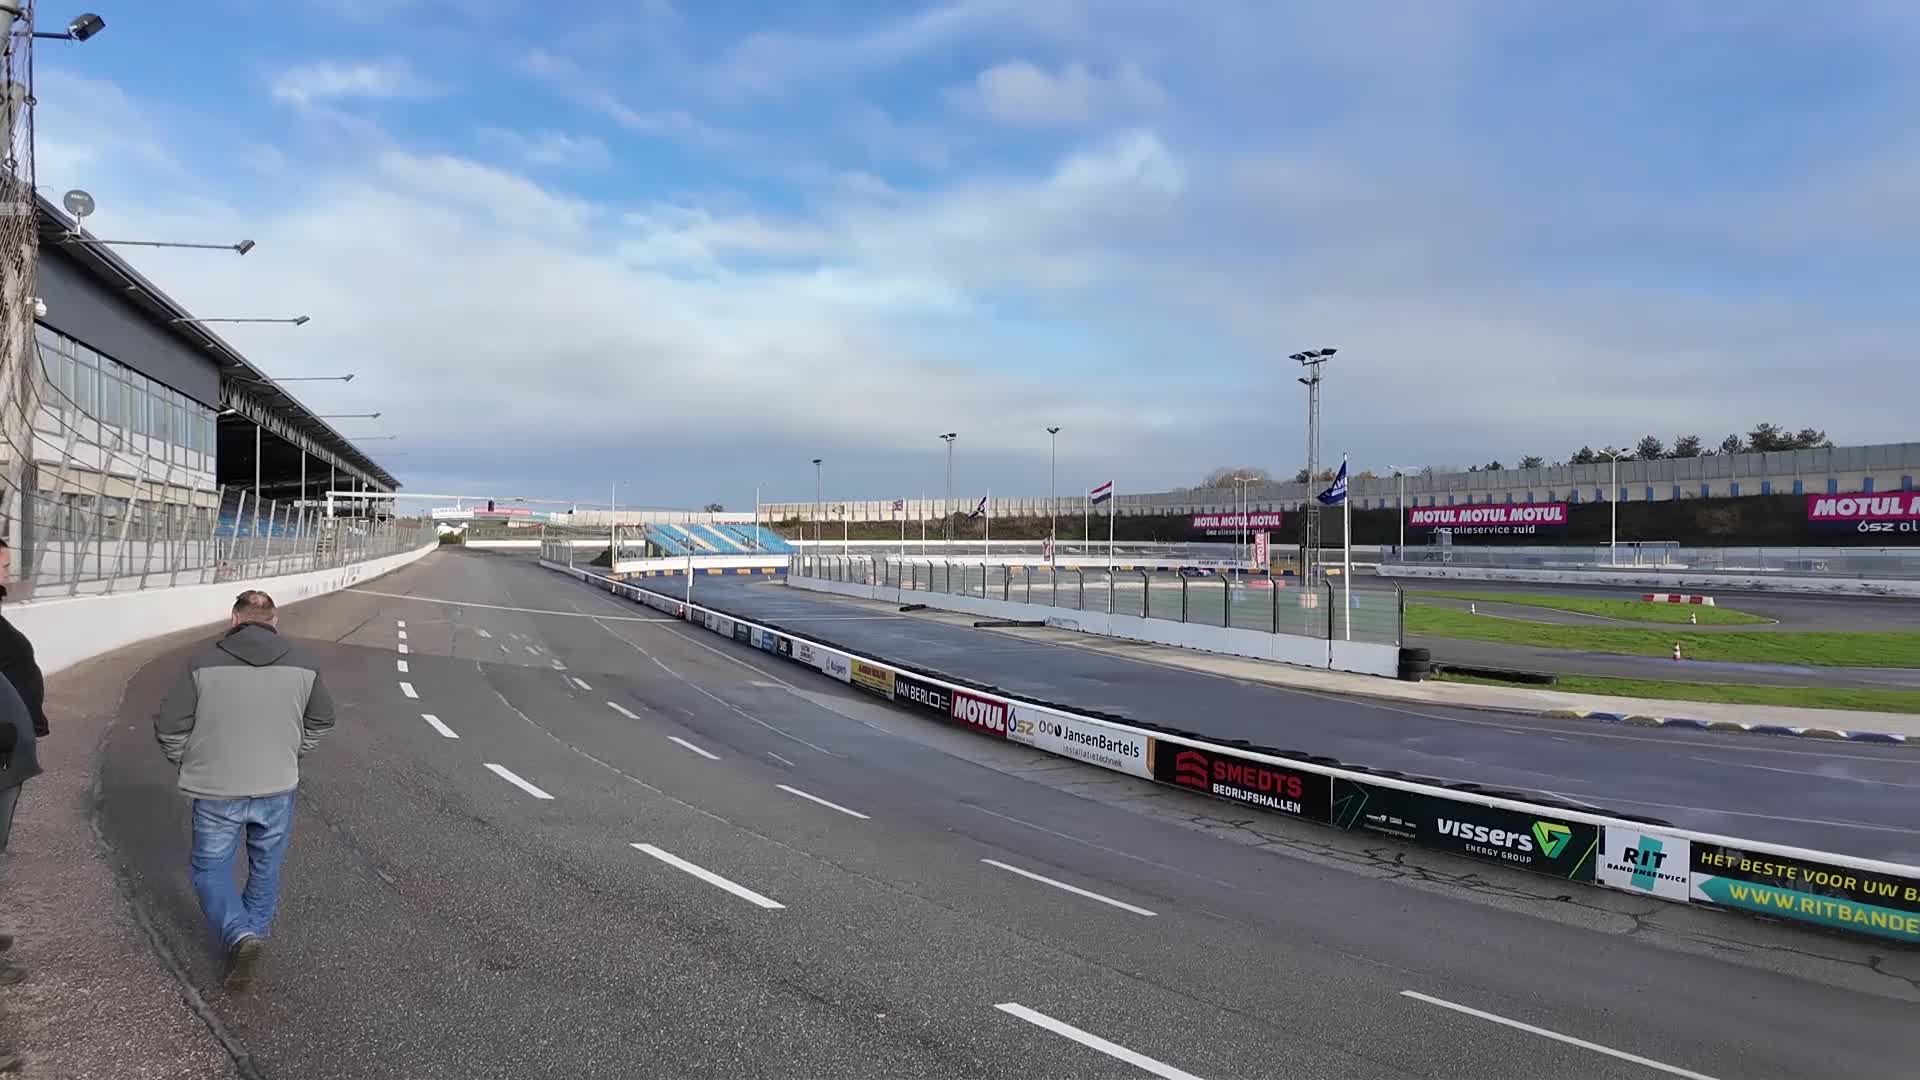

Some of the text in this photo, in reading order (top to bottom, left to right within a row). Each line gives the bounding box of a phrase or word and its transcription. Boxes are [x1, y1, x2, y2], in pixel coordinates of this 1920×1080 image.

[1411, 507, 1563, 523] MOTUL MOTUL MOTUL
[1813, 497, 1904, 516] MOTUL
[1193, 514, 1280, 527] MOTUL MOTUL MOTUL
[1453, 525, 1510, 535] olieservice
[1513, 524, 1536, 534] zuid
[895, 680, 910, 698] VAN
[953, 695, 1006, 732] MOTUL
[1063, 726, 1140, 758] JansenBartels
[1212, 760, 1303, 799] SMEDTS
[1212, 783, 1301, 814] BEDRIJFSHALLEN
[1465, 843, 1533, 864] ENERGY GROUP
[1622, 846, 1668, 869] RIT
[1606, 863, 1688, 884] BANDENSERVICE
[1700, 852, 1736, 869] HET
[1740, 859, 1798, 880] BESTE
[1803, 869, 1857, 891] VOOR
[1863, 880, 1899, 898] UW
